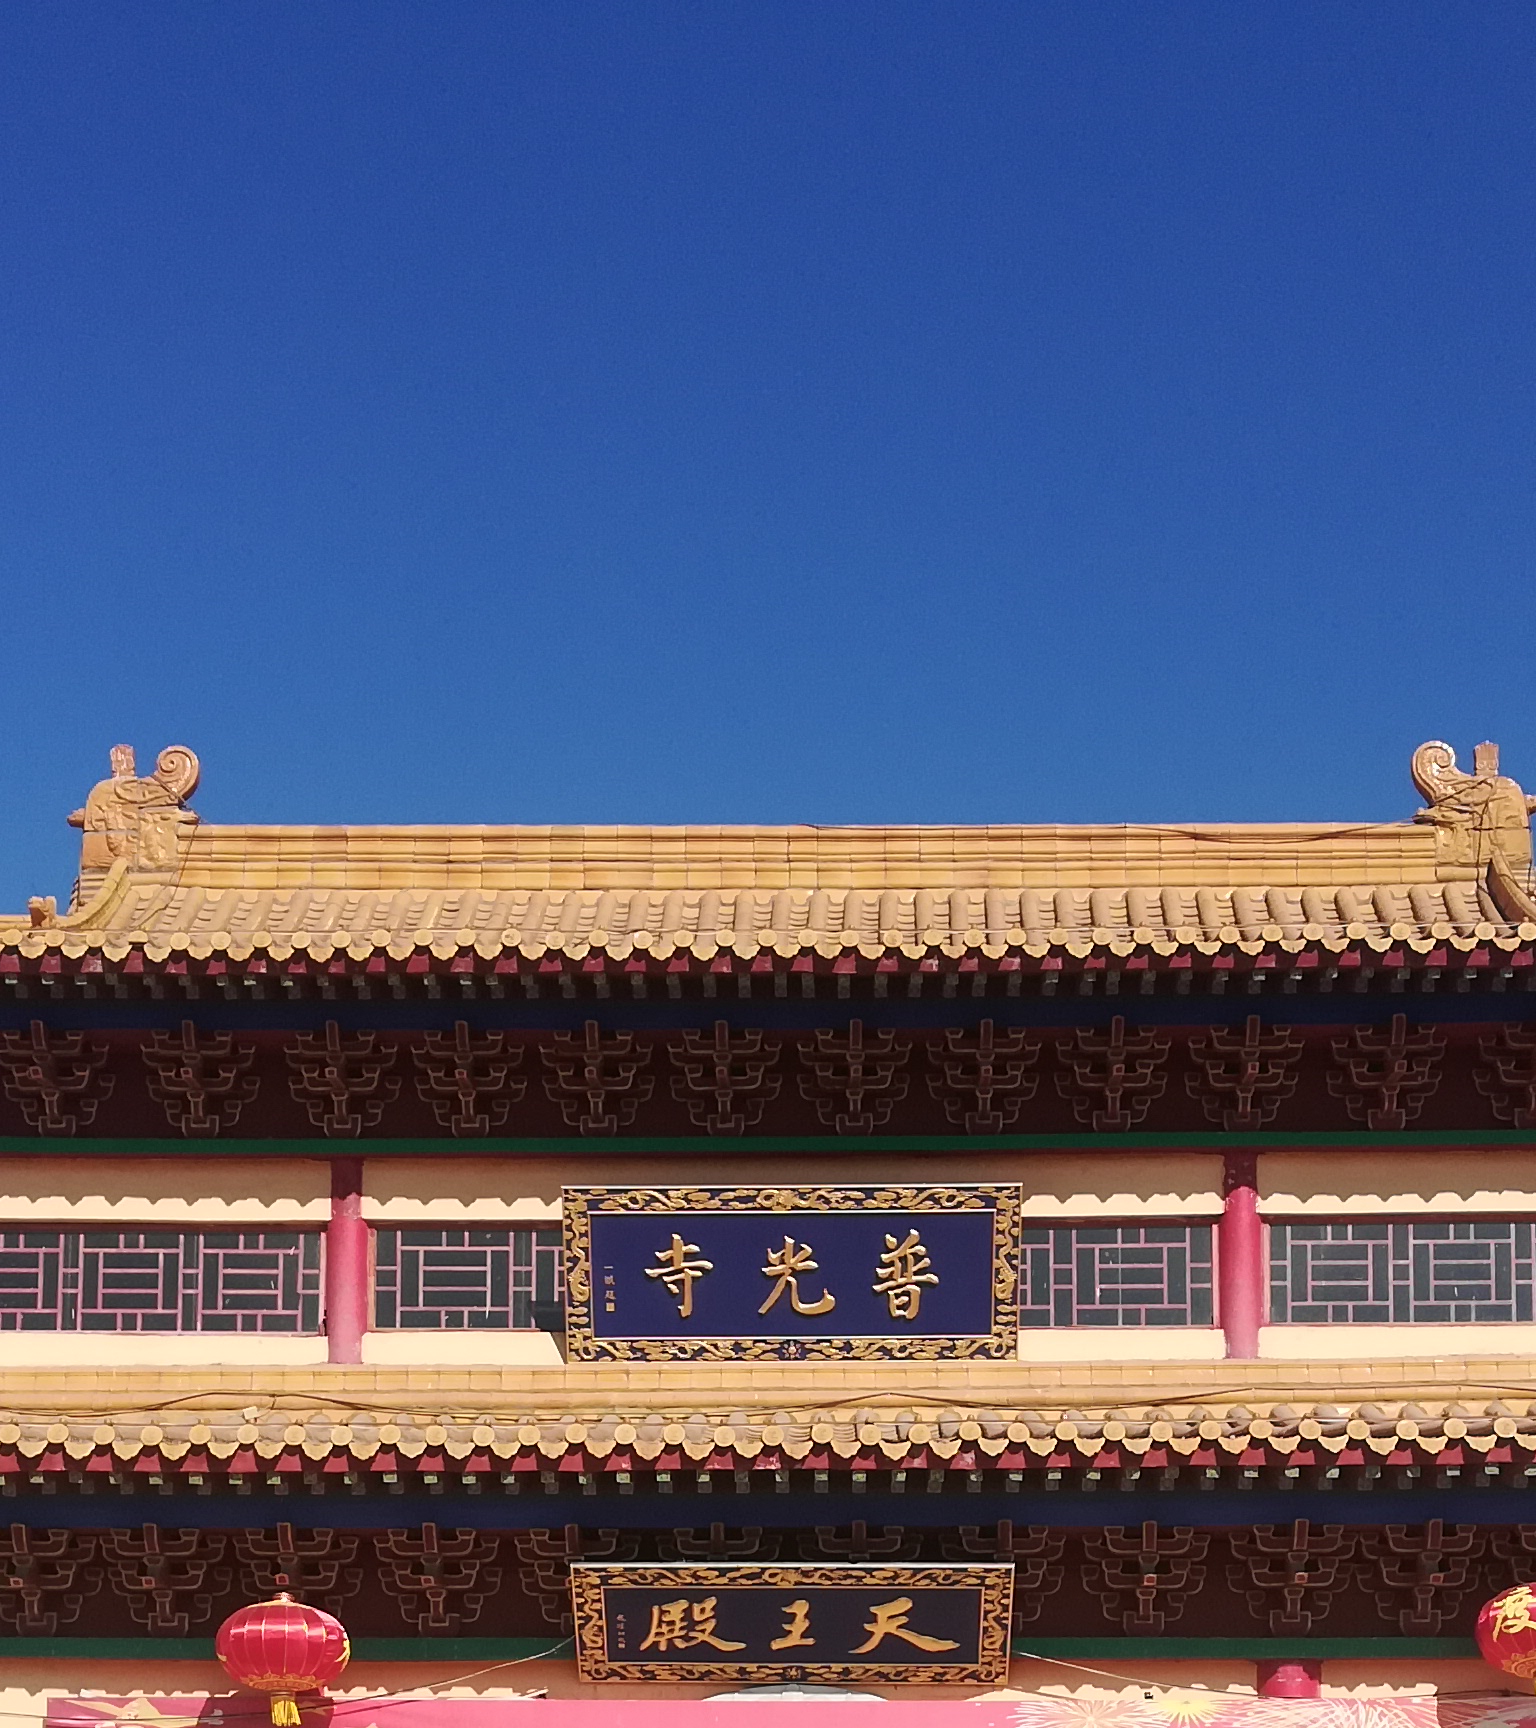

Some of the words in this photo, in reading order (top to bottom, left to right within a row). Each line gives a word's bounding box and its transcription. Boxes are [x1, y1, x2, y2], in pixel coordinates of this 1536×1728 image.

[644, 1228, 940, 1321] 普光寺
[639, 1596, 961, 1655] 天王殿
